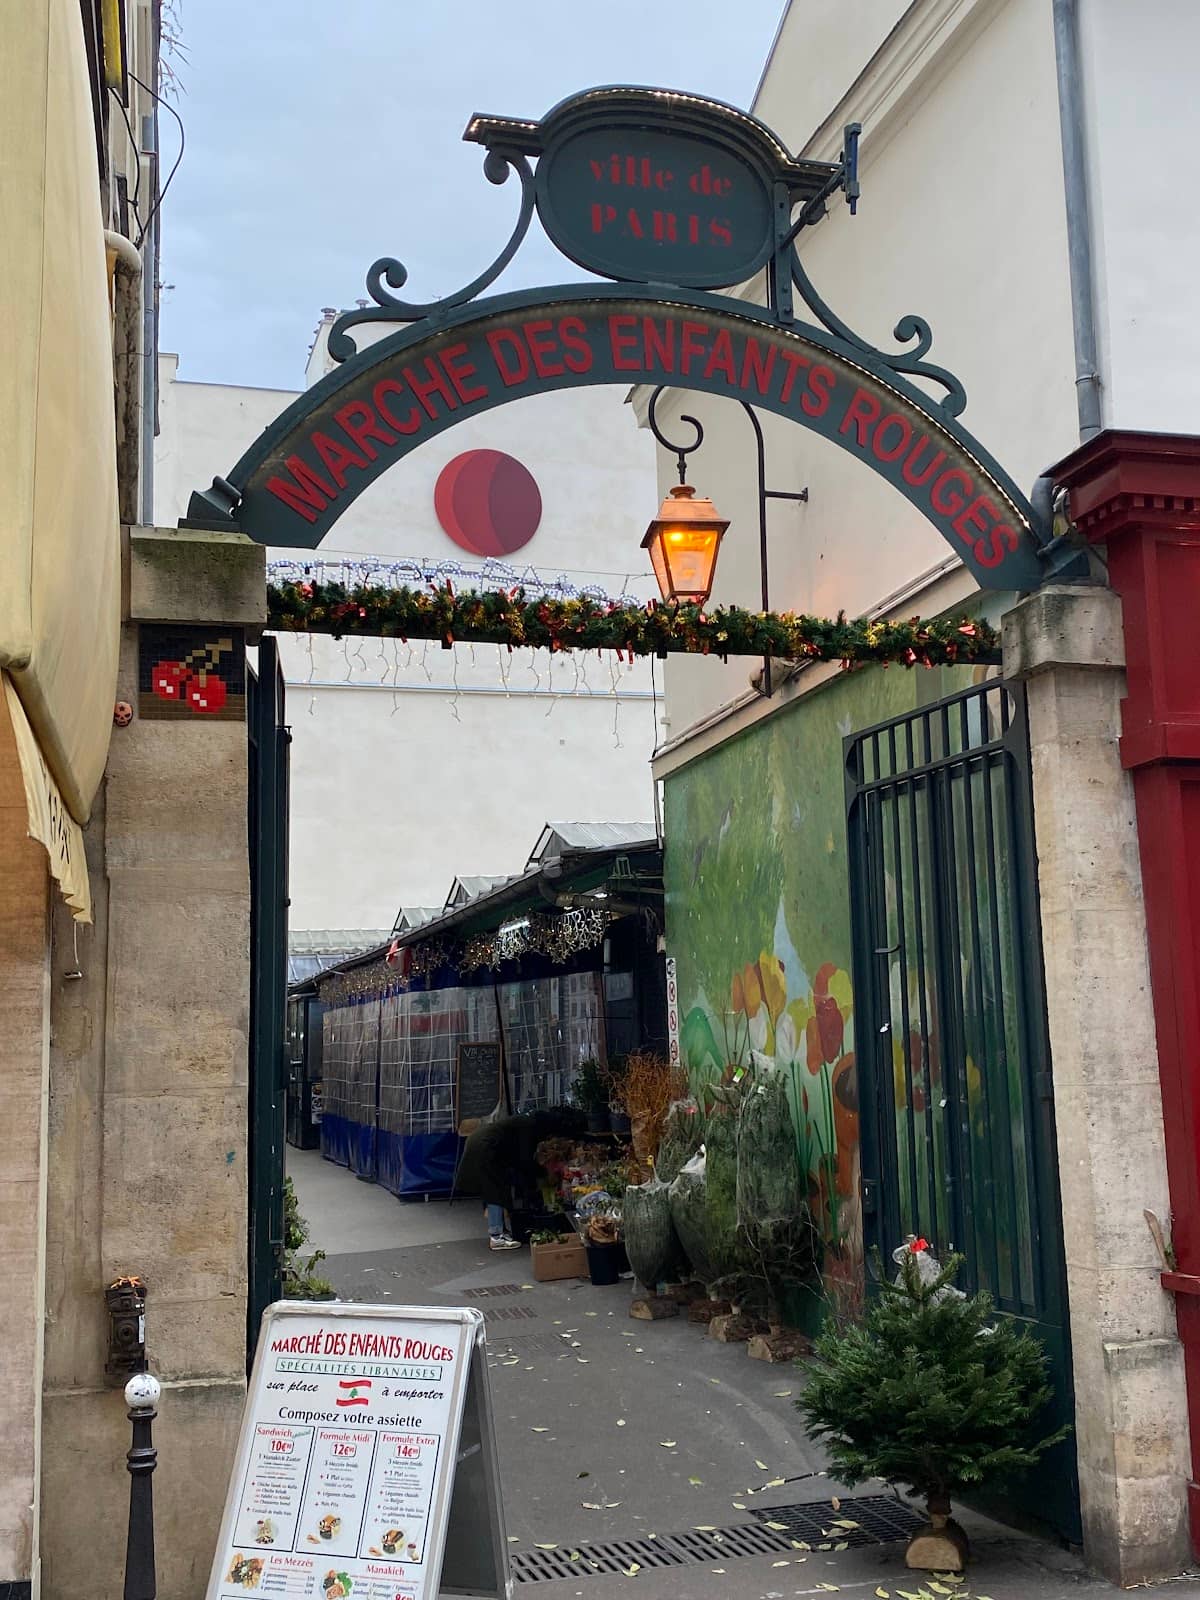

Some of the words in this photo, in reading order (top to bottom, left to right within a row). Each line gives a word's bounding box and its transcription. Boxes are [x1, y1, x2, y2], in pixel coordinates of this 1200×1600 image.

[590, 153, 675, 193] ville
[689, 162, 733, 198] de
[591, 202, 734, 248] PARIS
[267, 344, 487, 521] MARCHE
[488, 317, 592, 385] DES
[609, 316, 835, 416] ENFANTS
[840, 389, 1019, 568] ROUGES
[271, 1329, 324, 1354] MARCHÉ
[324, 1333, 347, 1356] DES
[349, 1334, 402, 1359] ENFANTS
[404, 1339, 454, 1361] ROUGES
[280, 1359, 356, 1374] SPÉCIALITÉS
[362, 1365, 436, 1378] LIBANAISES
[266, 1381, 285, 1391] sur
[288, 1380, 319, 1393] place
[381, 1386, 390, 1397] à
[394, 1388, 444, 1400] emporter
[278, 1406, 340, 1424] Composez
[343, 1412, 374, 1425] votre
[377, 1414, 422, 1428] assiette
[257, 1427, 293, 1437] Sandwich
[320, 1431, 350, 1441] Formule
[352, 1434, 370, 1443] Midi
[382, 1434, 413, 1444] Formule
[416, 1437, 436, 1446] Extra
[270, 1555, 282, 1565] Les
[367, 1564, 405, 1576] Manakich
